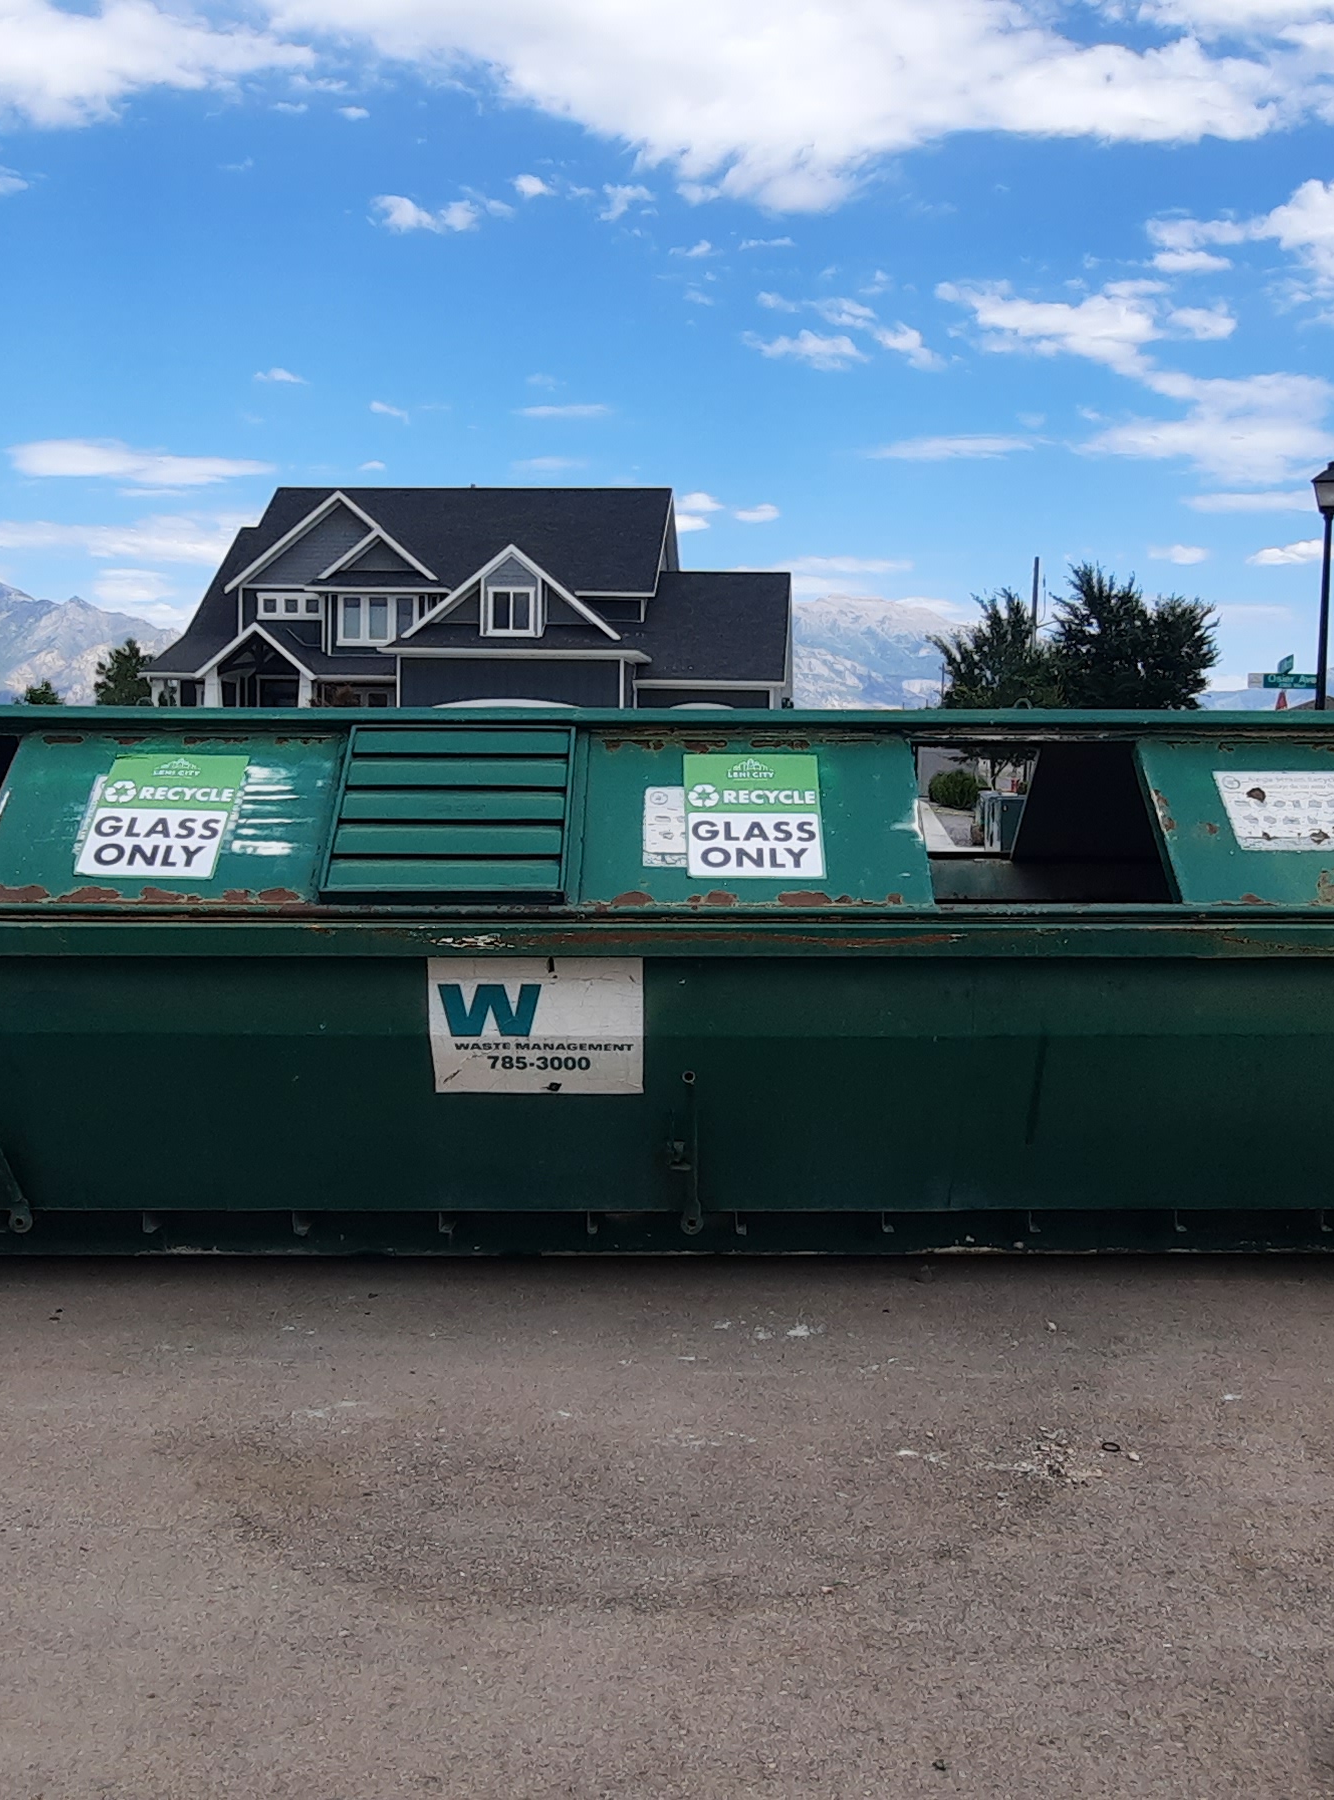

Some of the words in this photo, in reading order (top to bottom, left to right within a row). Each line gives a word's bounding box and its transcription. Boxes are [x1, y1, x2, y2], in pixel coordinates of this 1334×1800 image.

[178, 769, 202, 777] CITY
[139, 786, 234, 802] RECYCLE
[723, 789, 816, 804] RECYCLE
[94, 815, 221, 840] GLASS
[691, 820, 817, 842] GLASS
[93, 843, 209, 868] ONLY
[700, 847, 809, 869] ONLY
[454, 1042, 511, 1051] WASTE
[515, 1042, 634, 1052] MANAGEMENT
[487, 1055, 591, 1071] 785-3000
